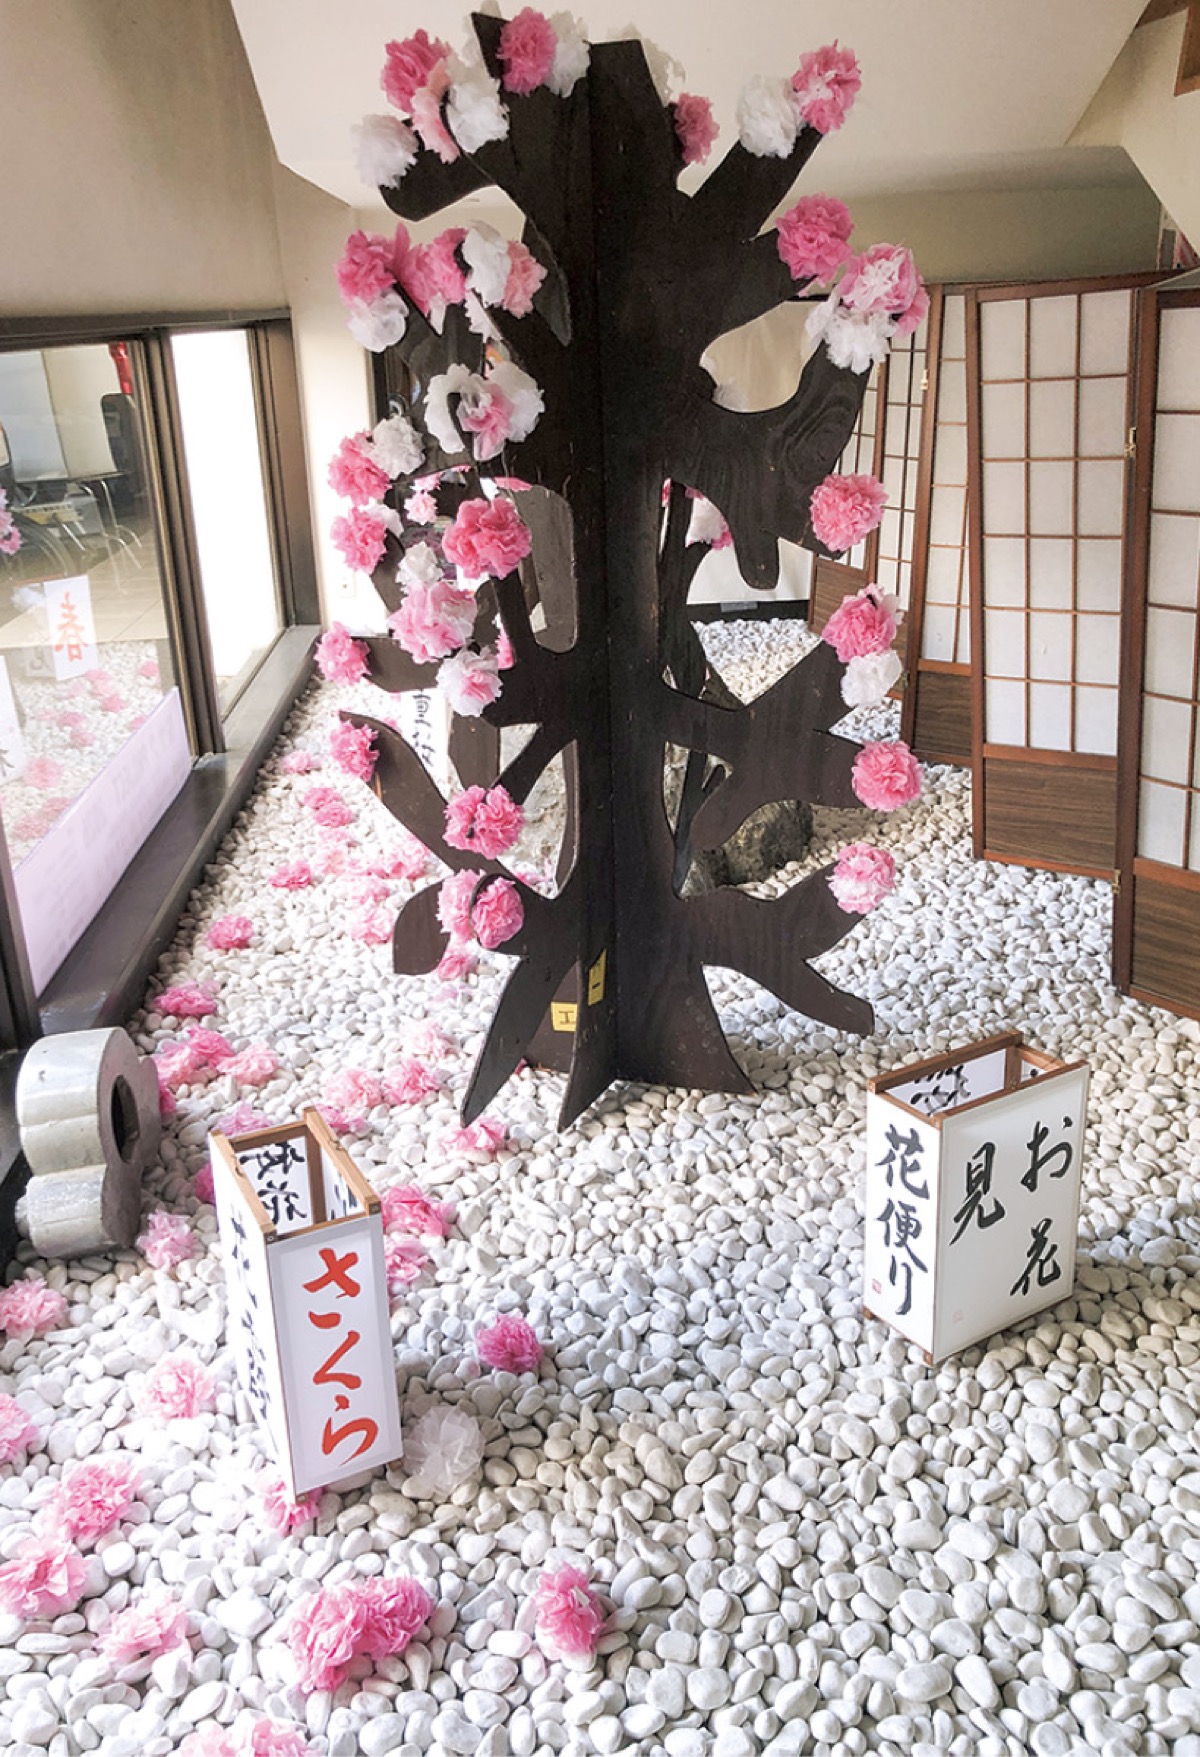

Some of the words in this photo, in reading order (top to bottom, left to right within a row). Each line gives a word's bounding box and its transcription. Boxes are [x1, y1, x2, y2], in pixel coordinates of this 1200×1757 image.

[875, 1124, 930, 1315] 花便り
[302, 1248, 379, 1465] さくら
